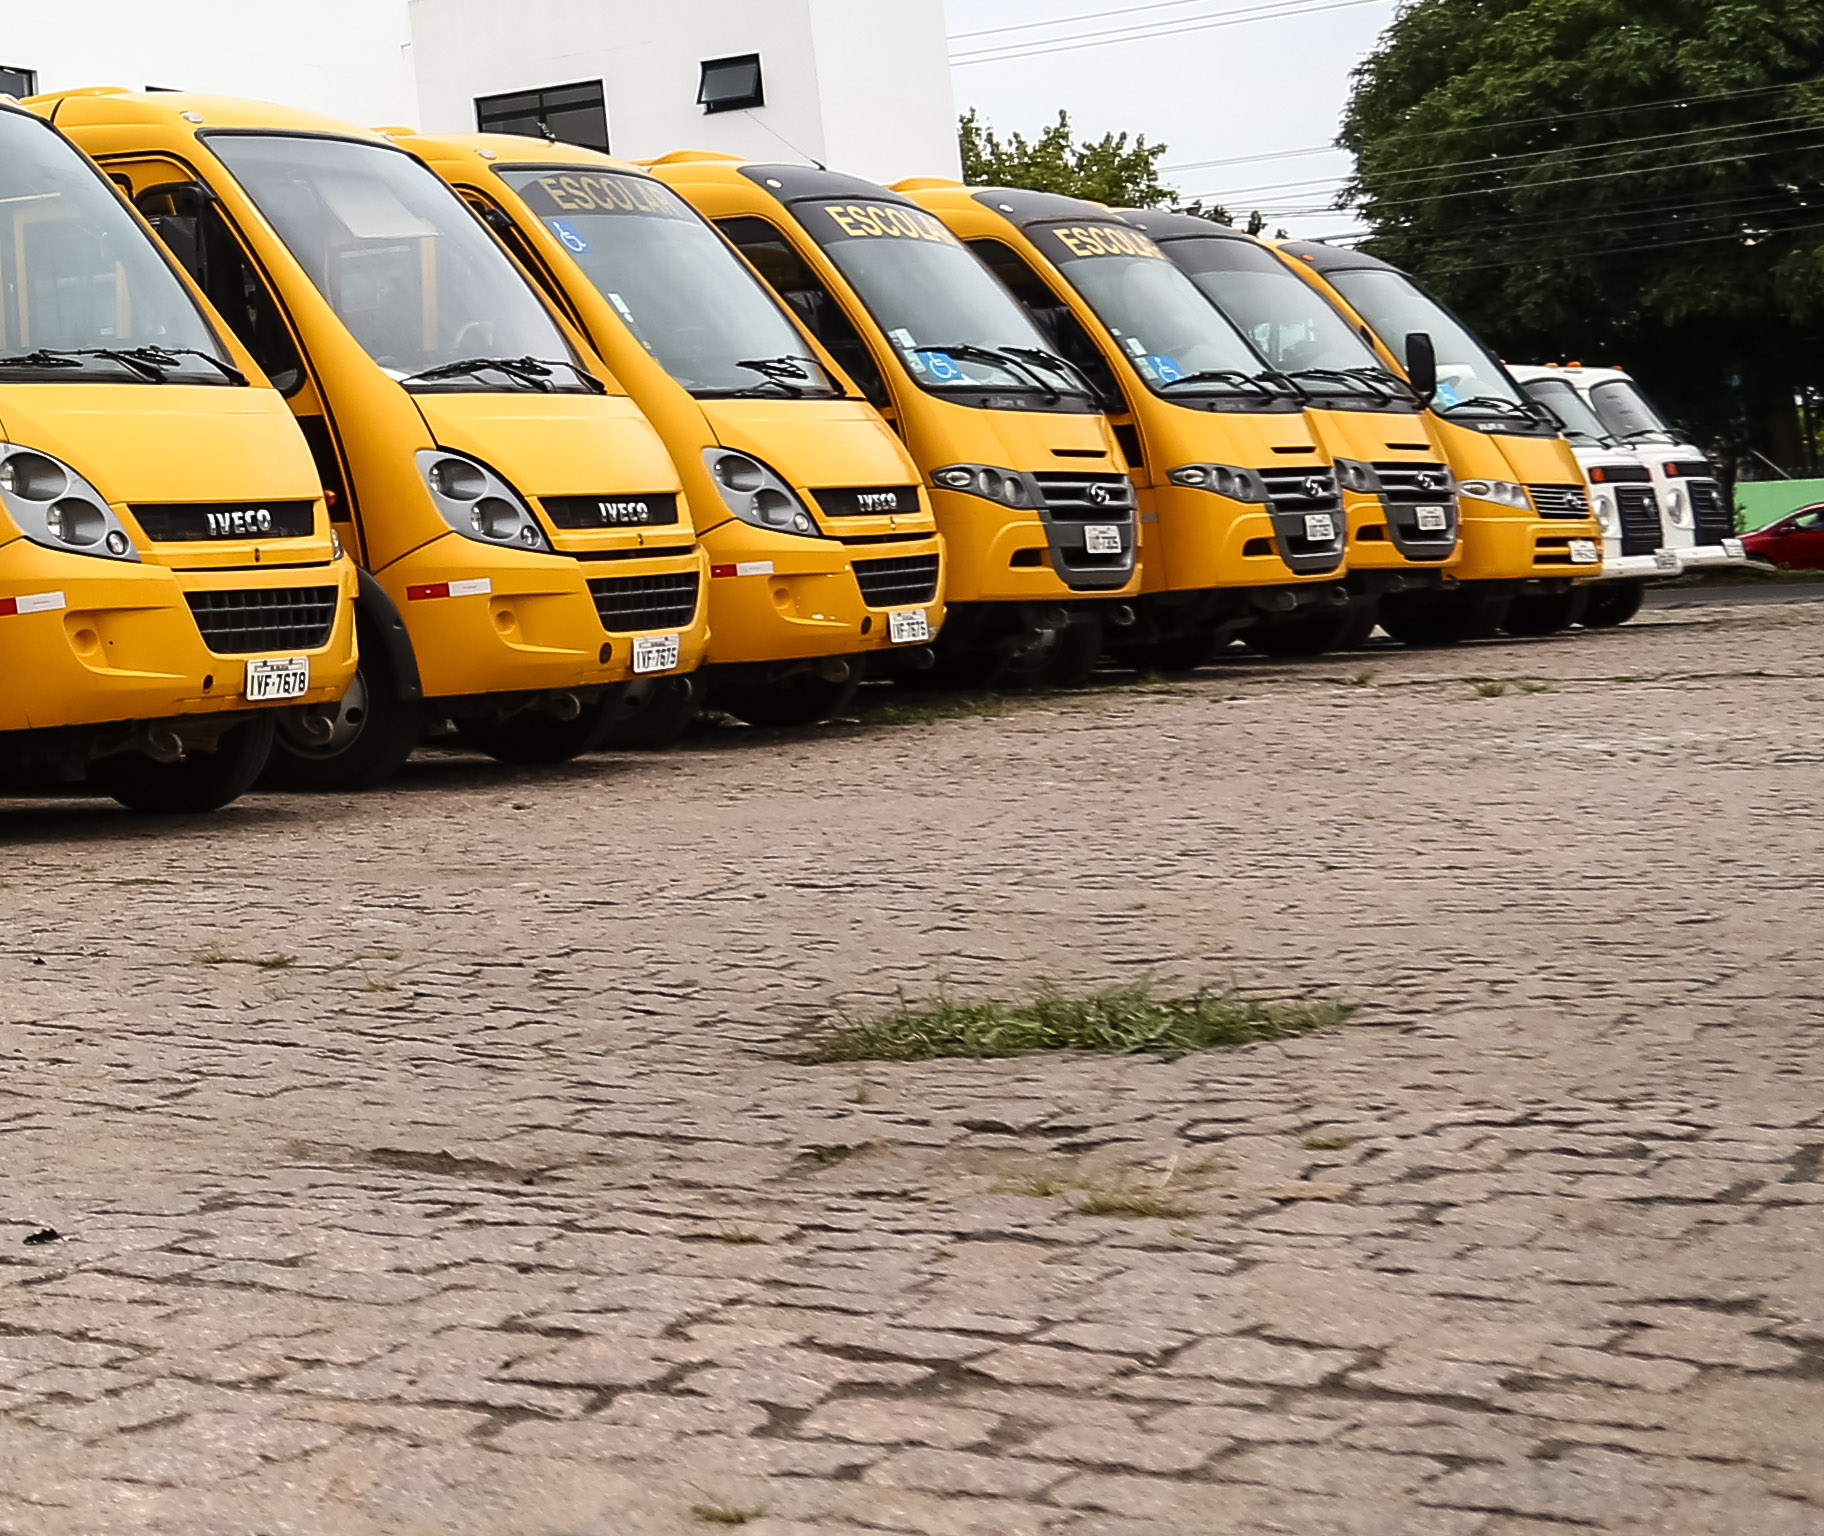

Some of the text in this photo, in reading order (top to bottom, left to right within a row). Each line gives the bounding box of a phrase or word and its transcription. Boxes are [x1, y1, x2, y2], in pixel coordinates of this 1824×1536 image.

[597, 502, 648, 523] IVECO
[857, 492, 897, 512] IVECO
[206, 508, 271, 536] IVECO
